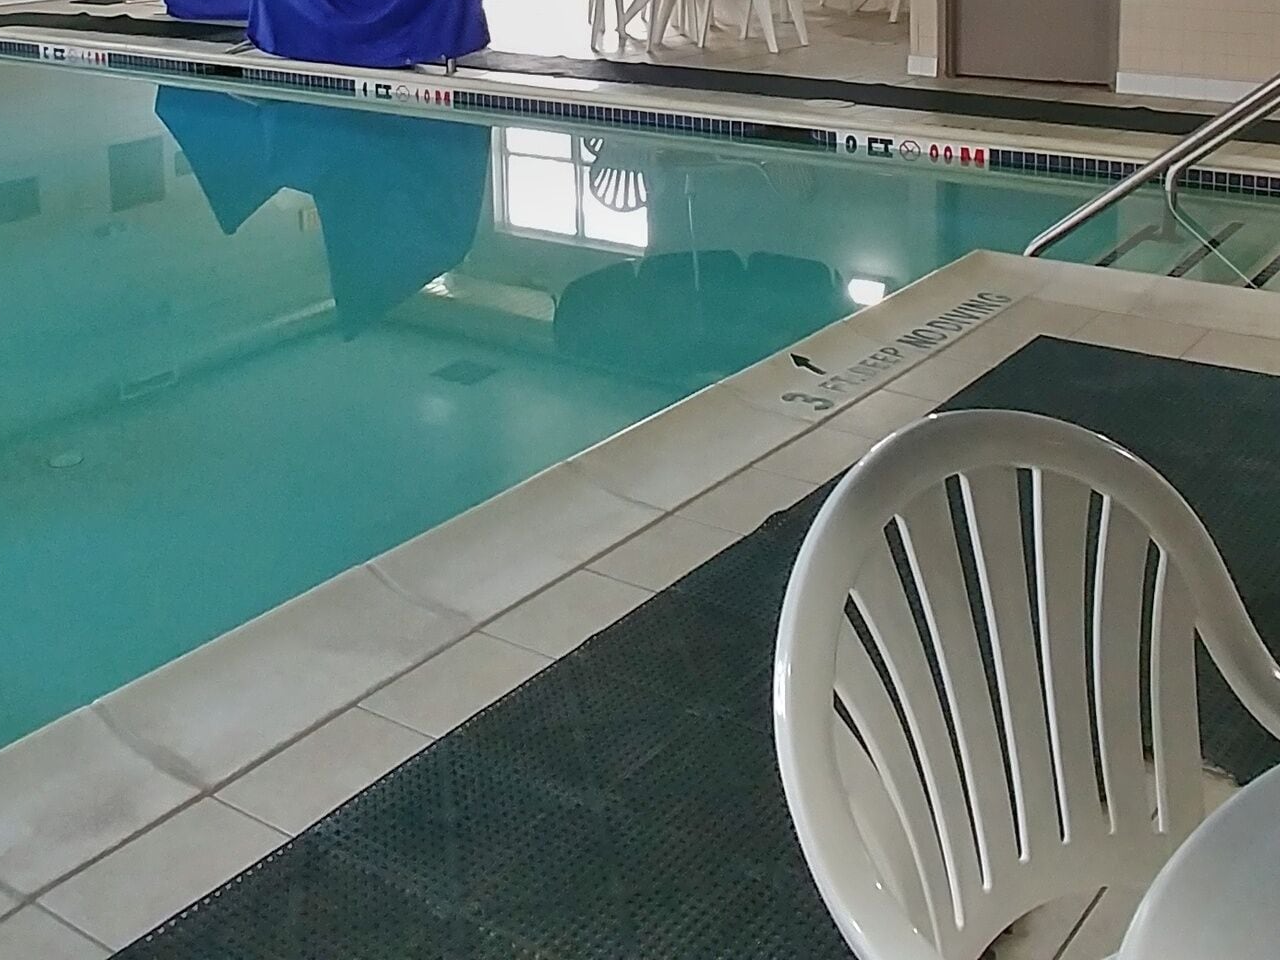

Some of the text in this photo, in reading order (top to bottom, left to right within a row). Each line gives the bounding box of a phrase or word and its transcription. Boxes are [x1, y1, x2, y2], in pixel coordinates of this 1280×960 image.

[781, 392, 835, 411] 3
[896, 329, 948, 349] NO
[926, 292, 1012, 332] DIVING
